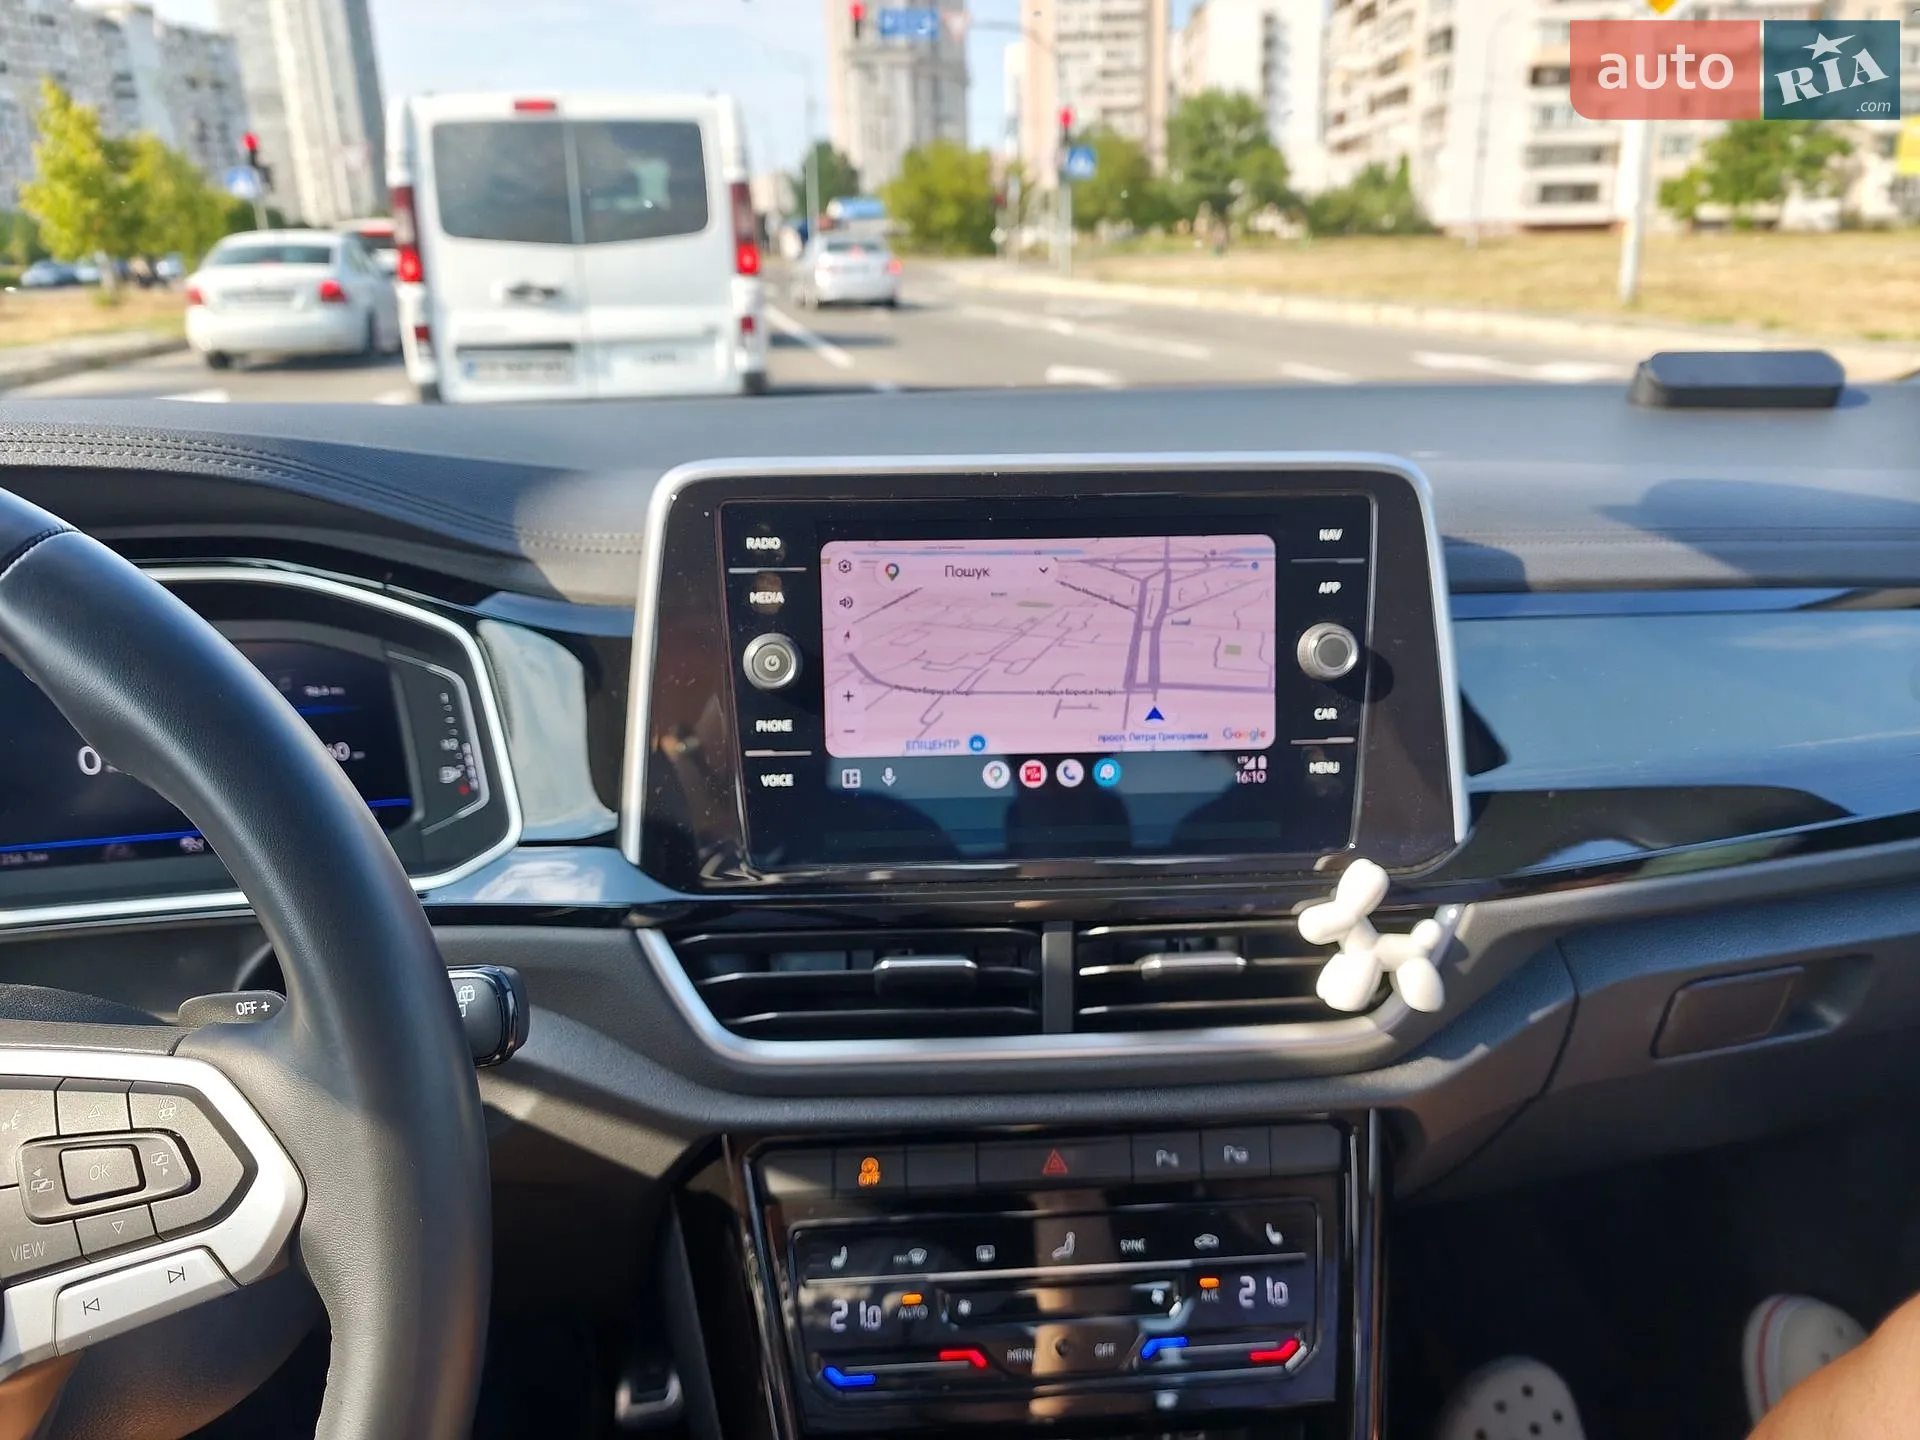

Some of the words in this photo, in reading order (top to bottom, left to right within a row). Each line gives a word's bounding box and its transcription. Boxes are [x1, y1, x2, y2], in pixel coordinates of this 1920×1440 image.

[1319, 528, 1343, 541] NAV
[746, 537, 781, 550] RADIO
[944, 565, 990, 580] Пошук
[1319, 581, 1342, 594] APP
[749, 591, 785, 604] MEDIA
[1314, 707, 1338, 720] CAR
[755, 719, 793, 732] PHONE
[1222, 727, 1267, 742] Google
[1309, 761, 1340, 774] MENU
[760, 773, 794, 787] VOICE
[1235, 770, 1267, 785] 16:10
[236, 1001, 257, 1016] OFF
[89, 1164, 111, 1181] OK
[10, 1240, 46, 1262] VIEW
